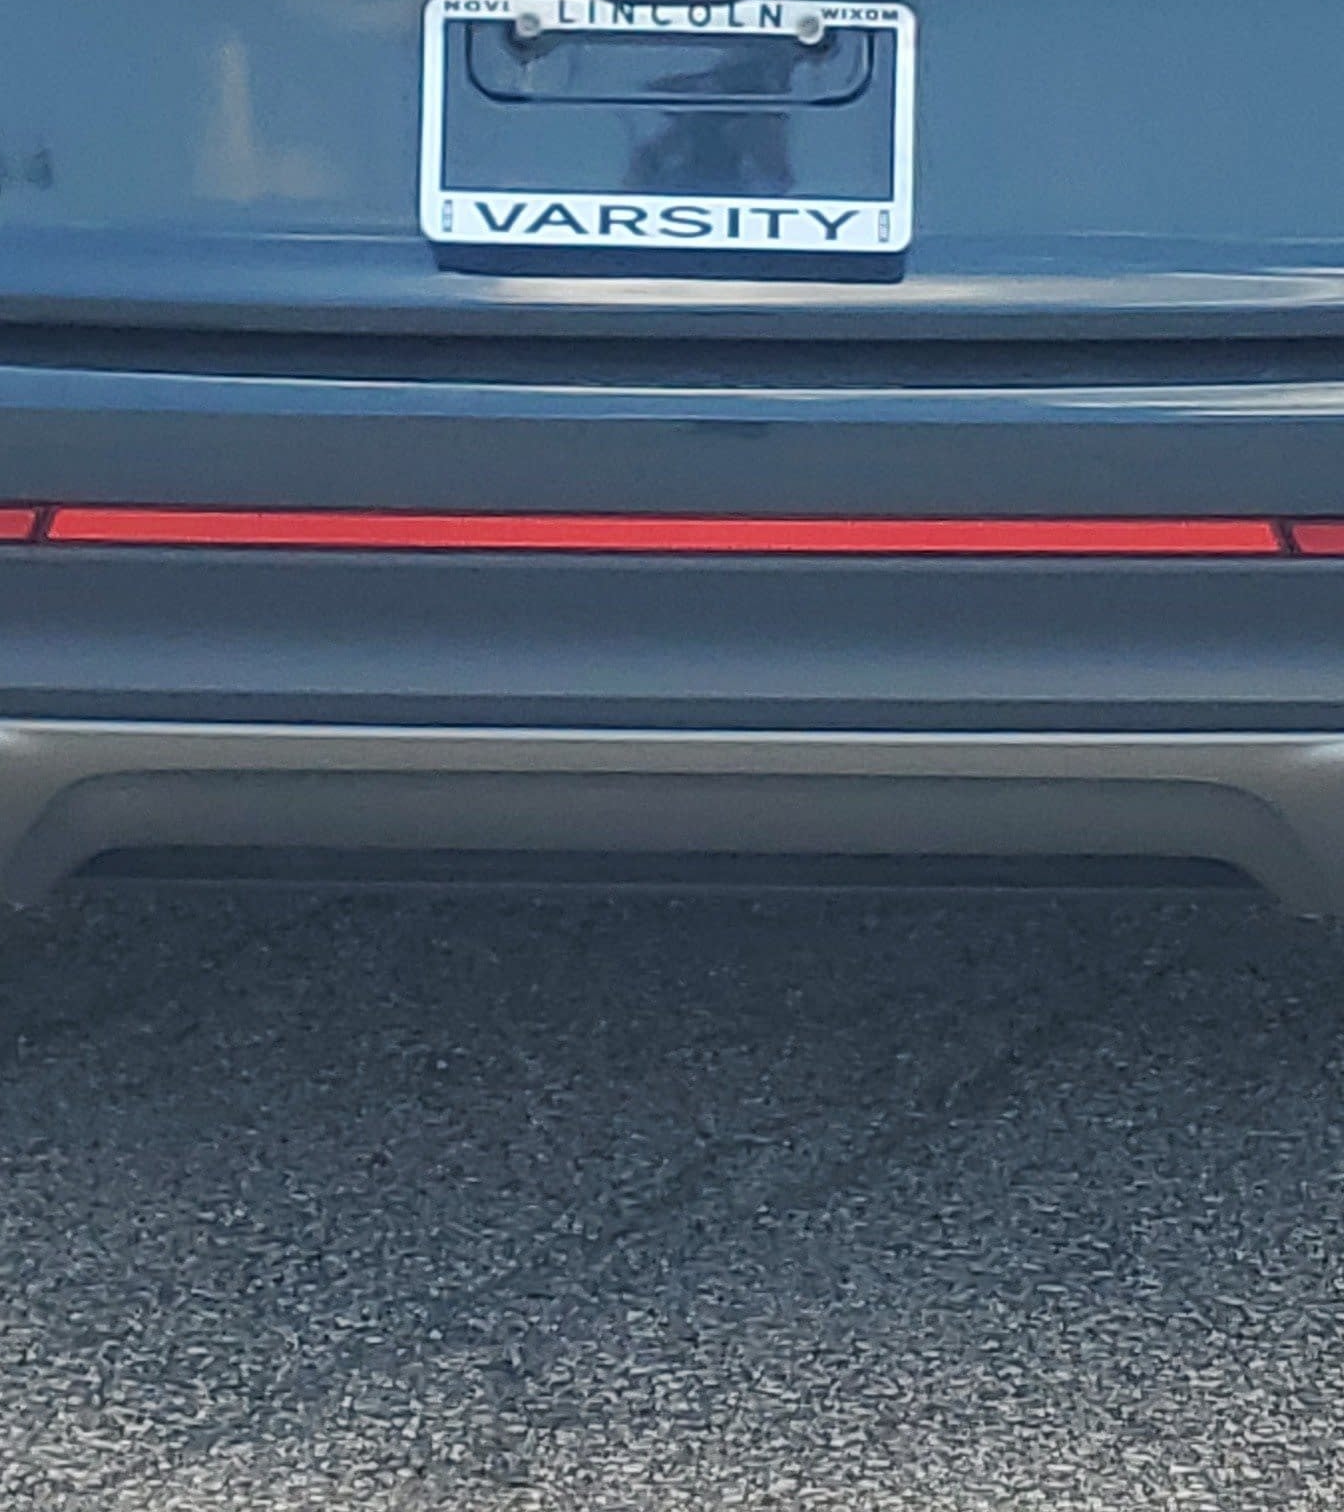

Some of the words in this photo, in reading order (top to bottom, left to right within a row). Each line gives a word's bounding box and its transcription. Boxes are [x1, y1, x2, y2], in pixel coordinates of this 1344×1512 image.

[443, 0, 511, 13] NOVI
[820, 7, 899, 21] WIXOM
[474, 201, 860, 241] VARSITY
